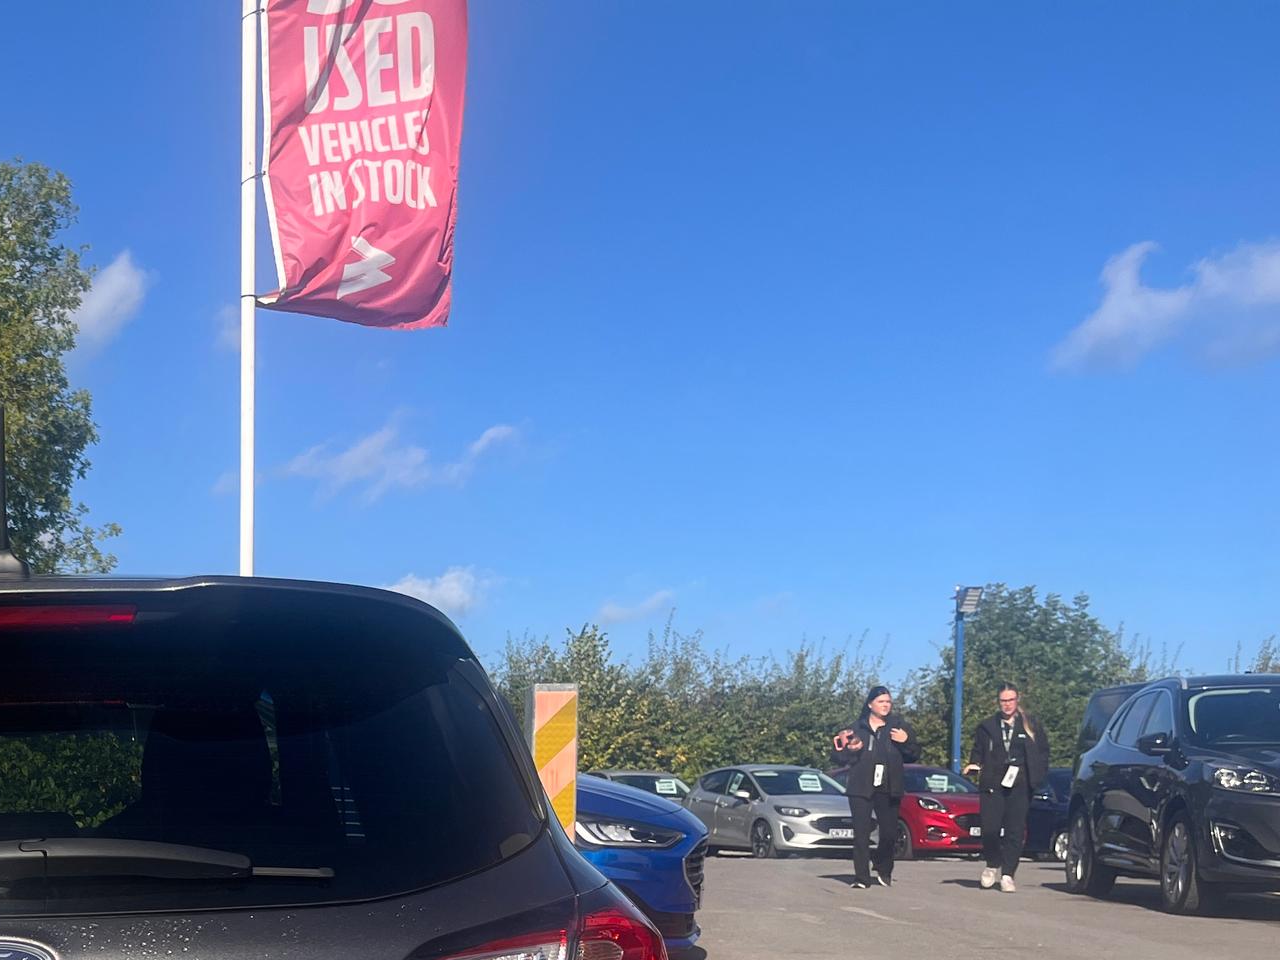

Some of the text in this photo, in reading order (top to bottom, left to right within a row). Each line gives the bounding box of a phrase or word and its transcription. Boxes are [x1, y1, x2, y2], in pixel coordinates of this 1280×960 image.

[303, 11, 435, 115] USED
[307, 158, 438, 217] IN STOCK
